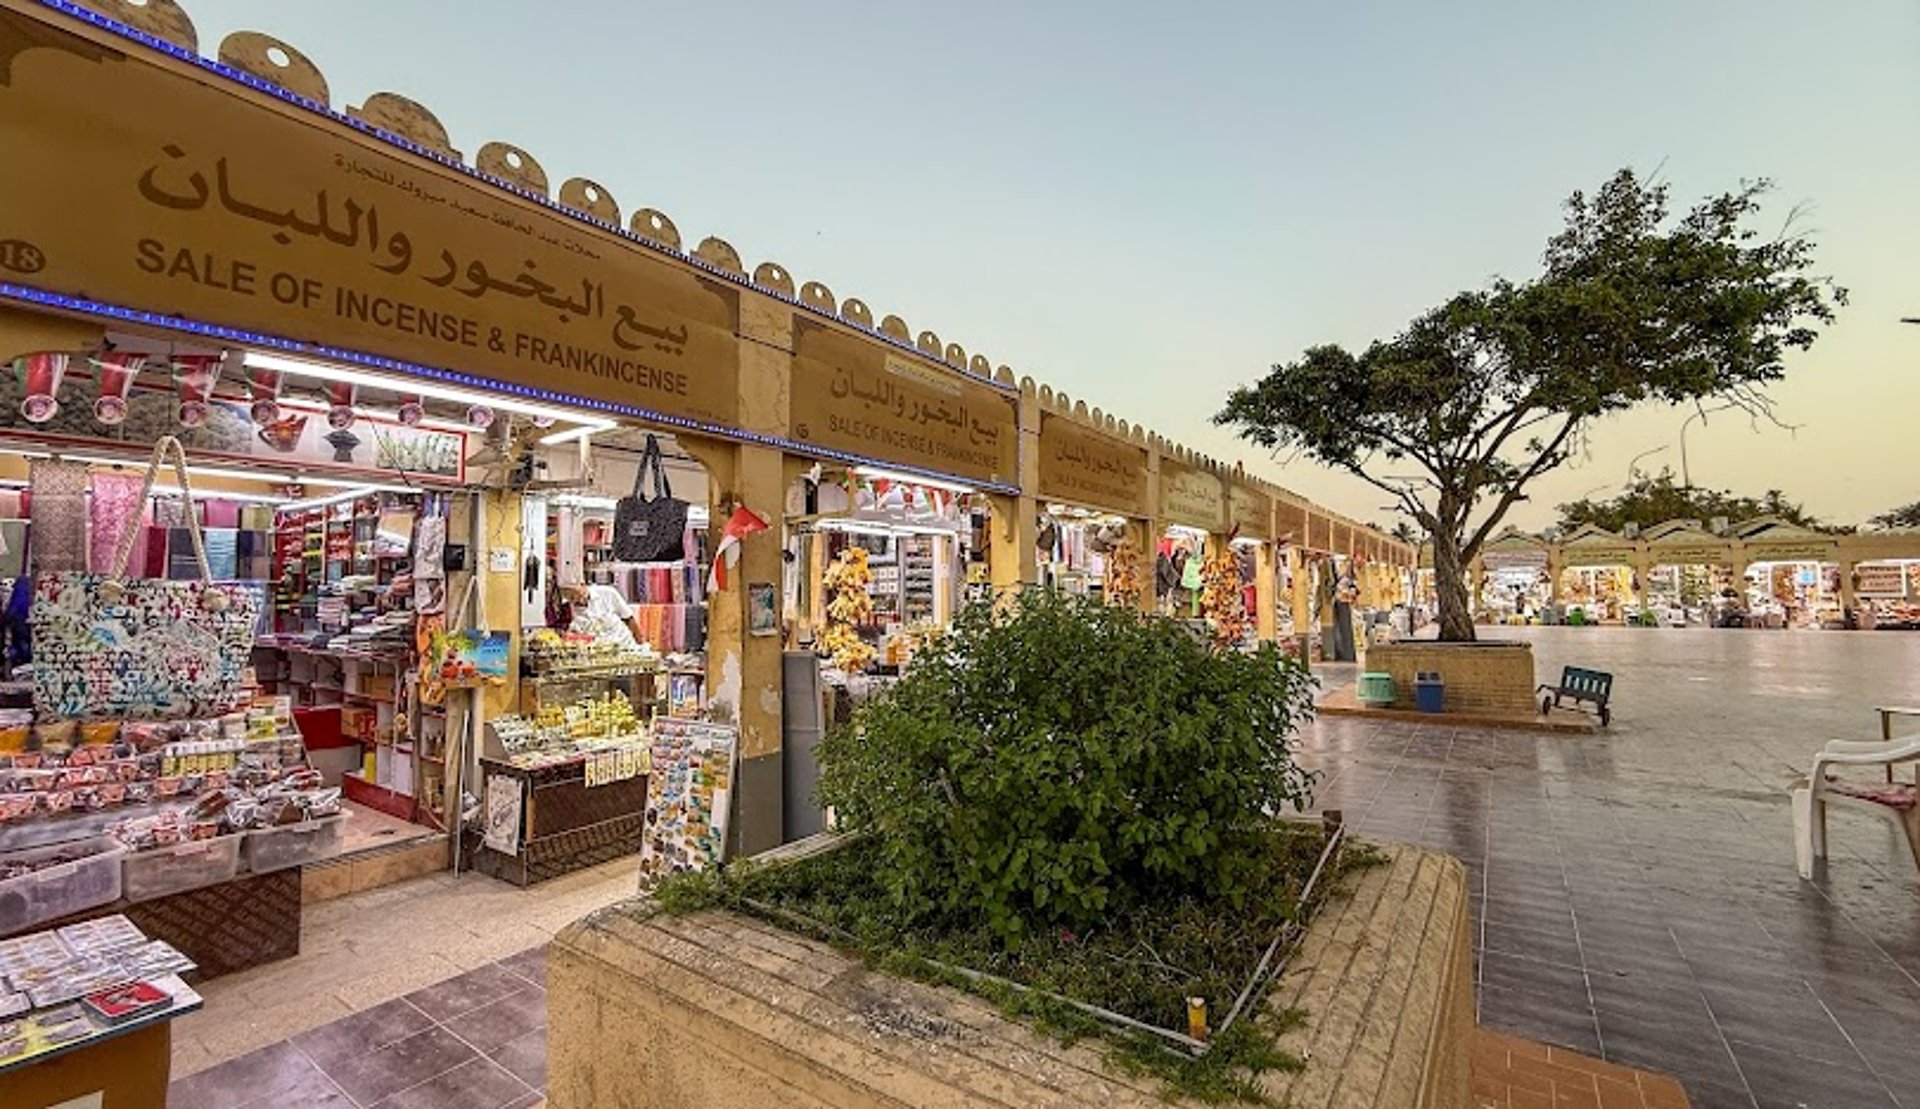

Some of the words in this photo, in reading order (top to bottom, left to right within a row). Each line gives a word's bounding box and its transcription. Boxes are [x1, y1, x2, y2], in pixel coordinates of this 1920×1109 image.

[334, 153, 395, 186] للتجارة
[138, 144, 413, 275] واللبان
[3, 243, 40, 271] 18
[422, 247, 605, 324] البخور
[136, 238, 256, 297] SALE
[271, 272, 323, 309] OF
[335, 286, 479, 348] INCENSE
[487, 326, 507, 354] &
[515, 332, 689, 397] FRANKINCENSE
[611, 303, 689, 357] بيع
[830, 366, 906, 417] واللبان
[828, 414, 861, 438] SALE
[864, 423, 880, 441] OF
[881, 428, 927, 453] INCENSE
[908, 400, 969, 436] البخور
[969, 416, 1000, 447] بيع
